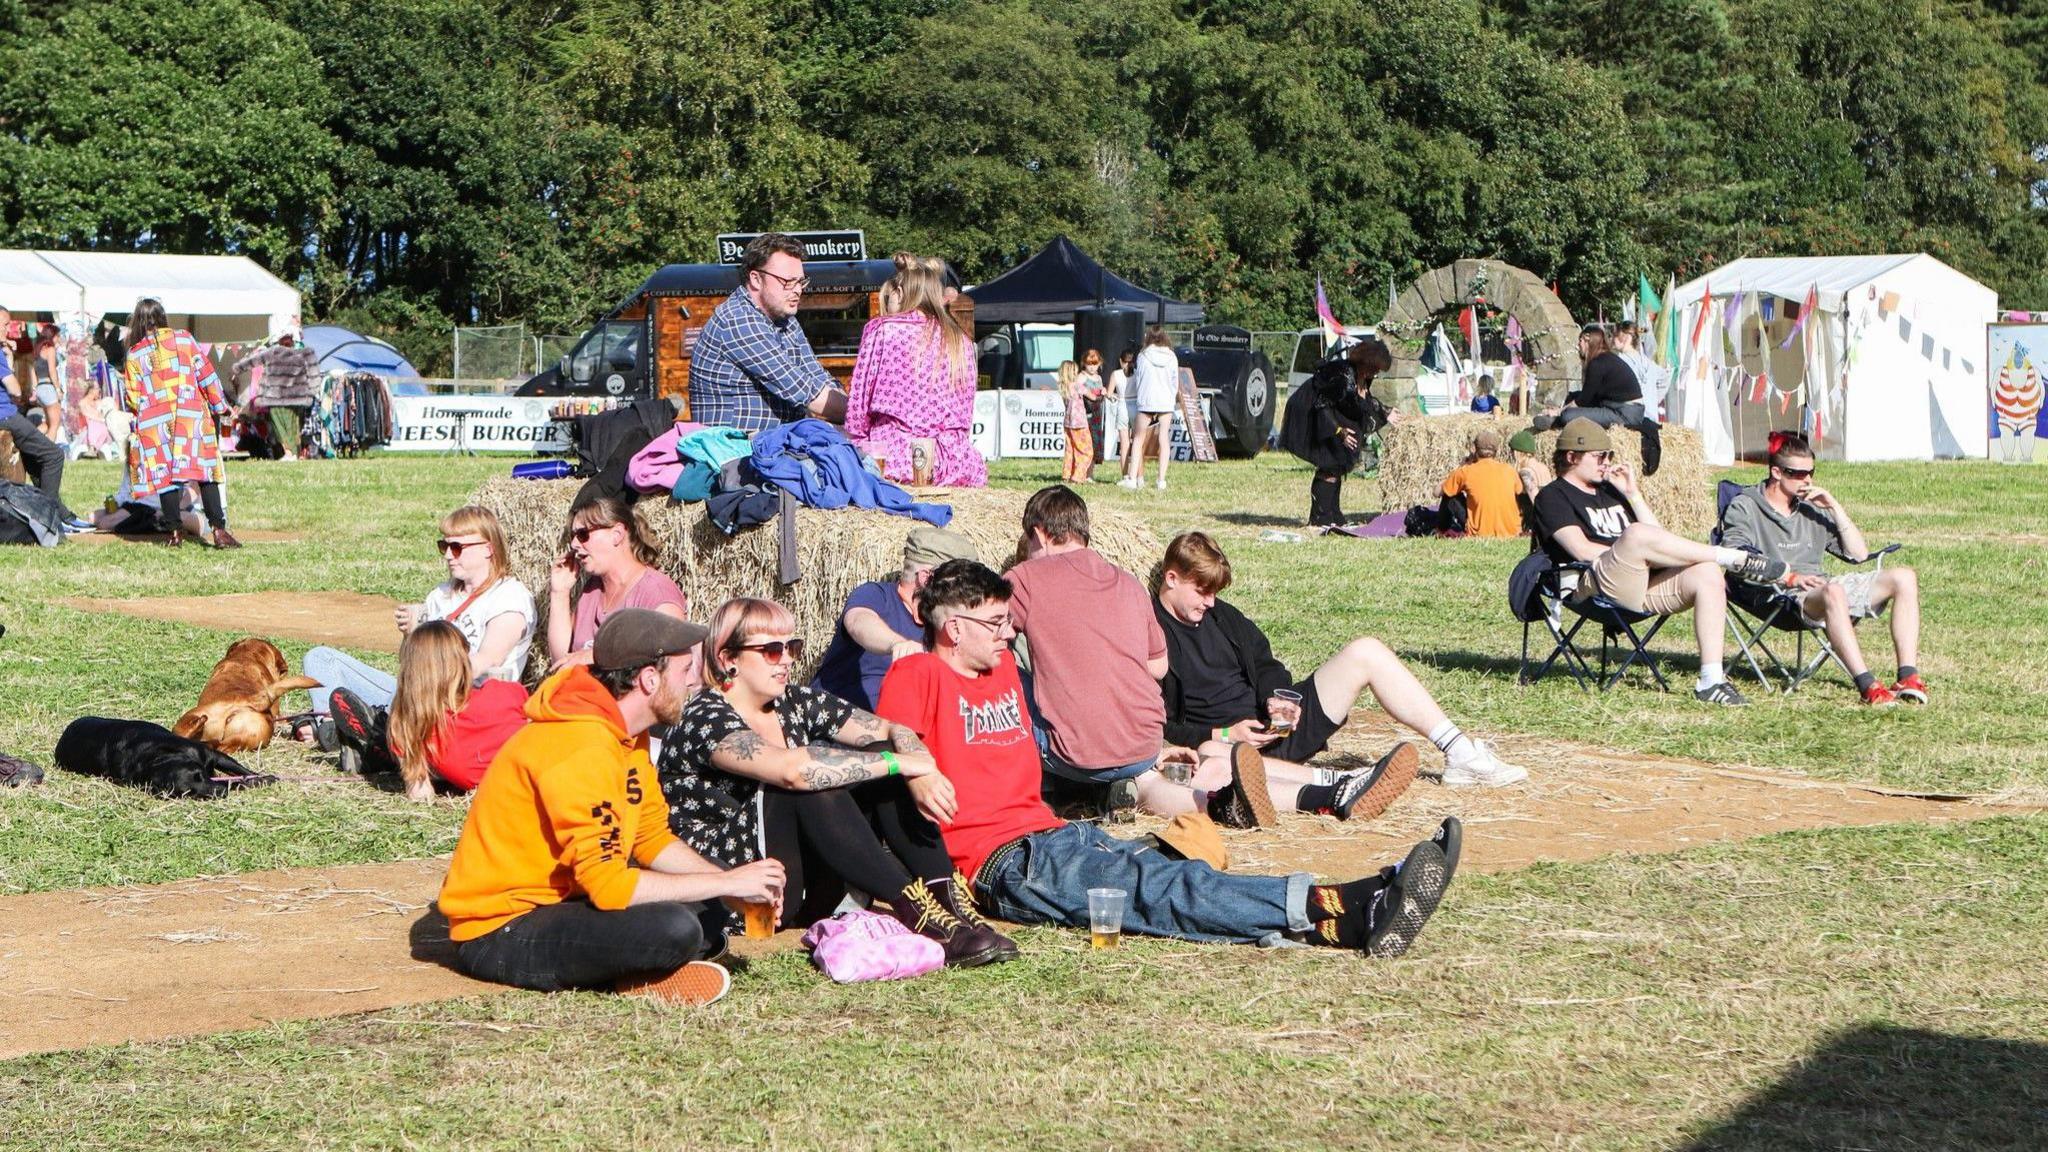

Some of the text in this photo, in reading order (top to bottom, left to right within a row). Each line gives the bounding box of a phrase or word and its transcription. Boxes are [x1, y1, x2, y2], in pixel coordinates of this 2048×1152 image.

[806, 239, 861, 258] mokery
[422, 406, 513, 419] Hommade
[1025, 408, 1065, 417] Homema
[399, 425, 557, 442] EESE BURGER
[1019, 421, 1063, 435] CHEE
[1019, 437, 1064, 451] BURG
